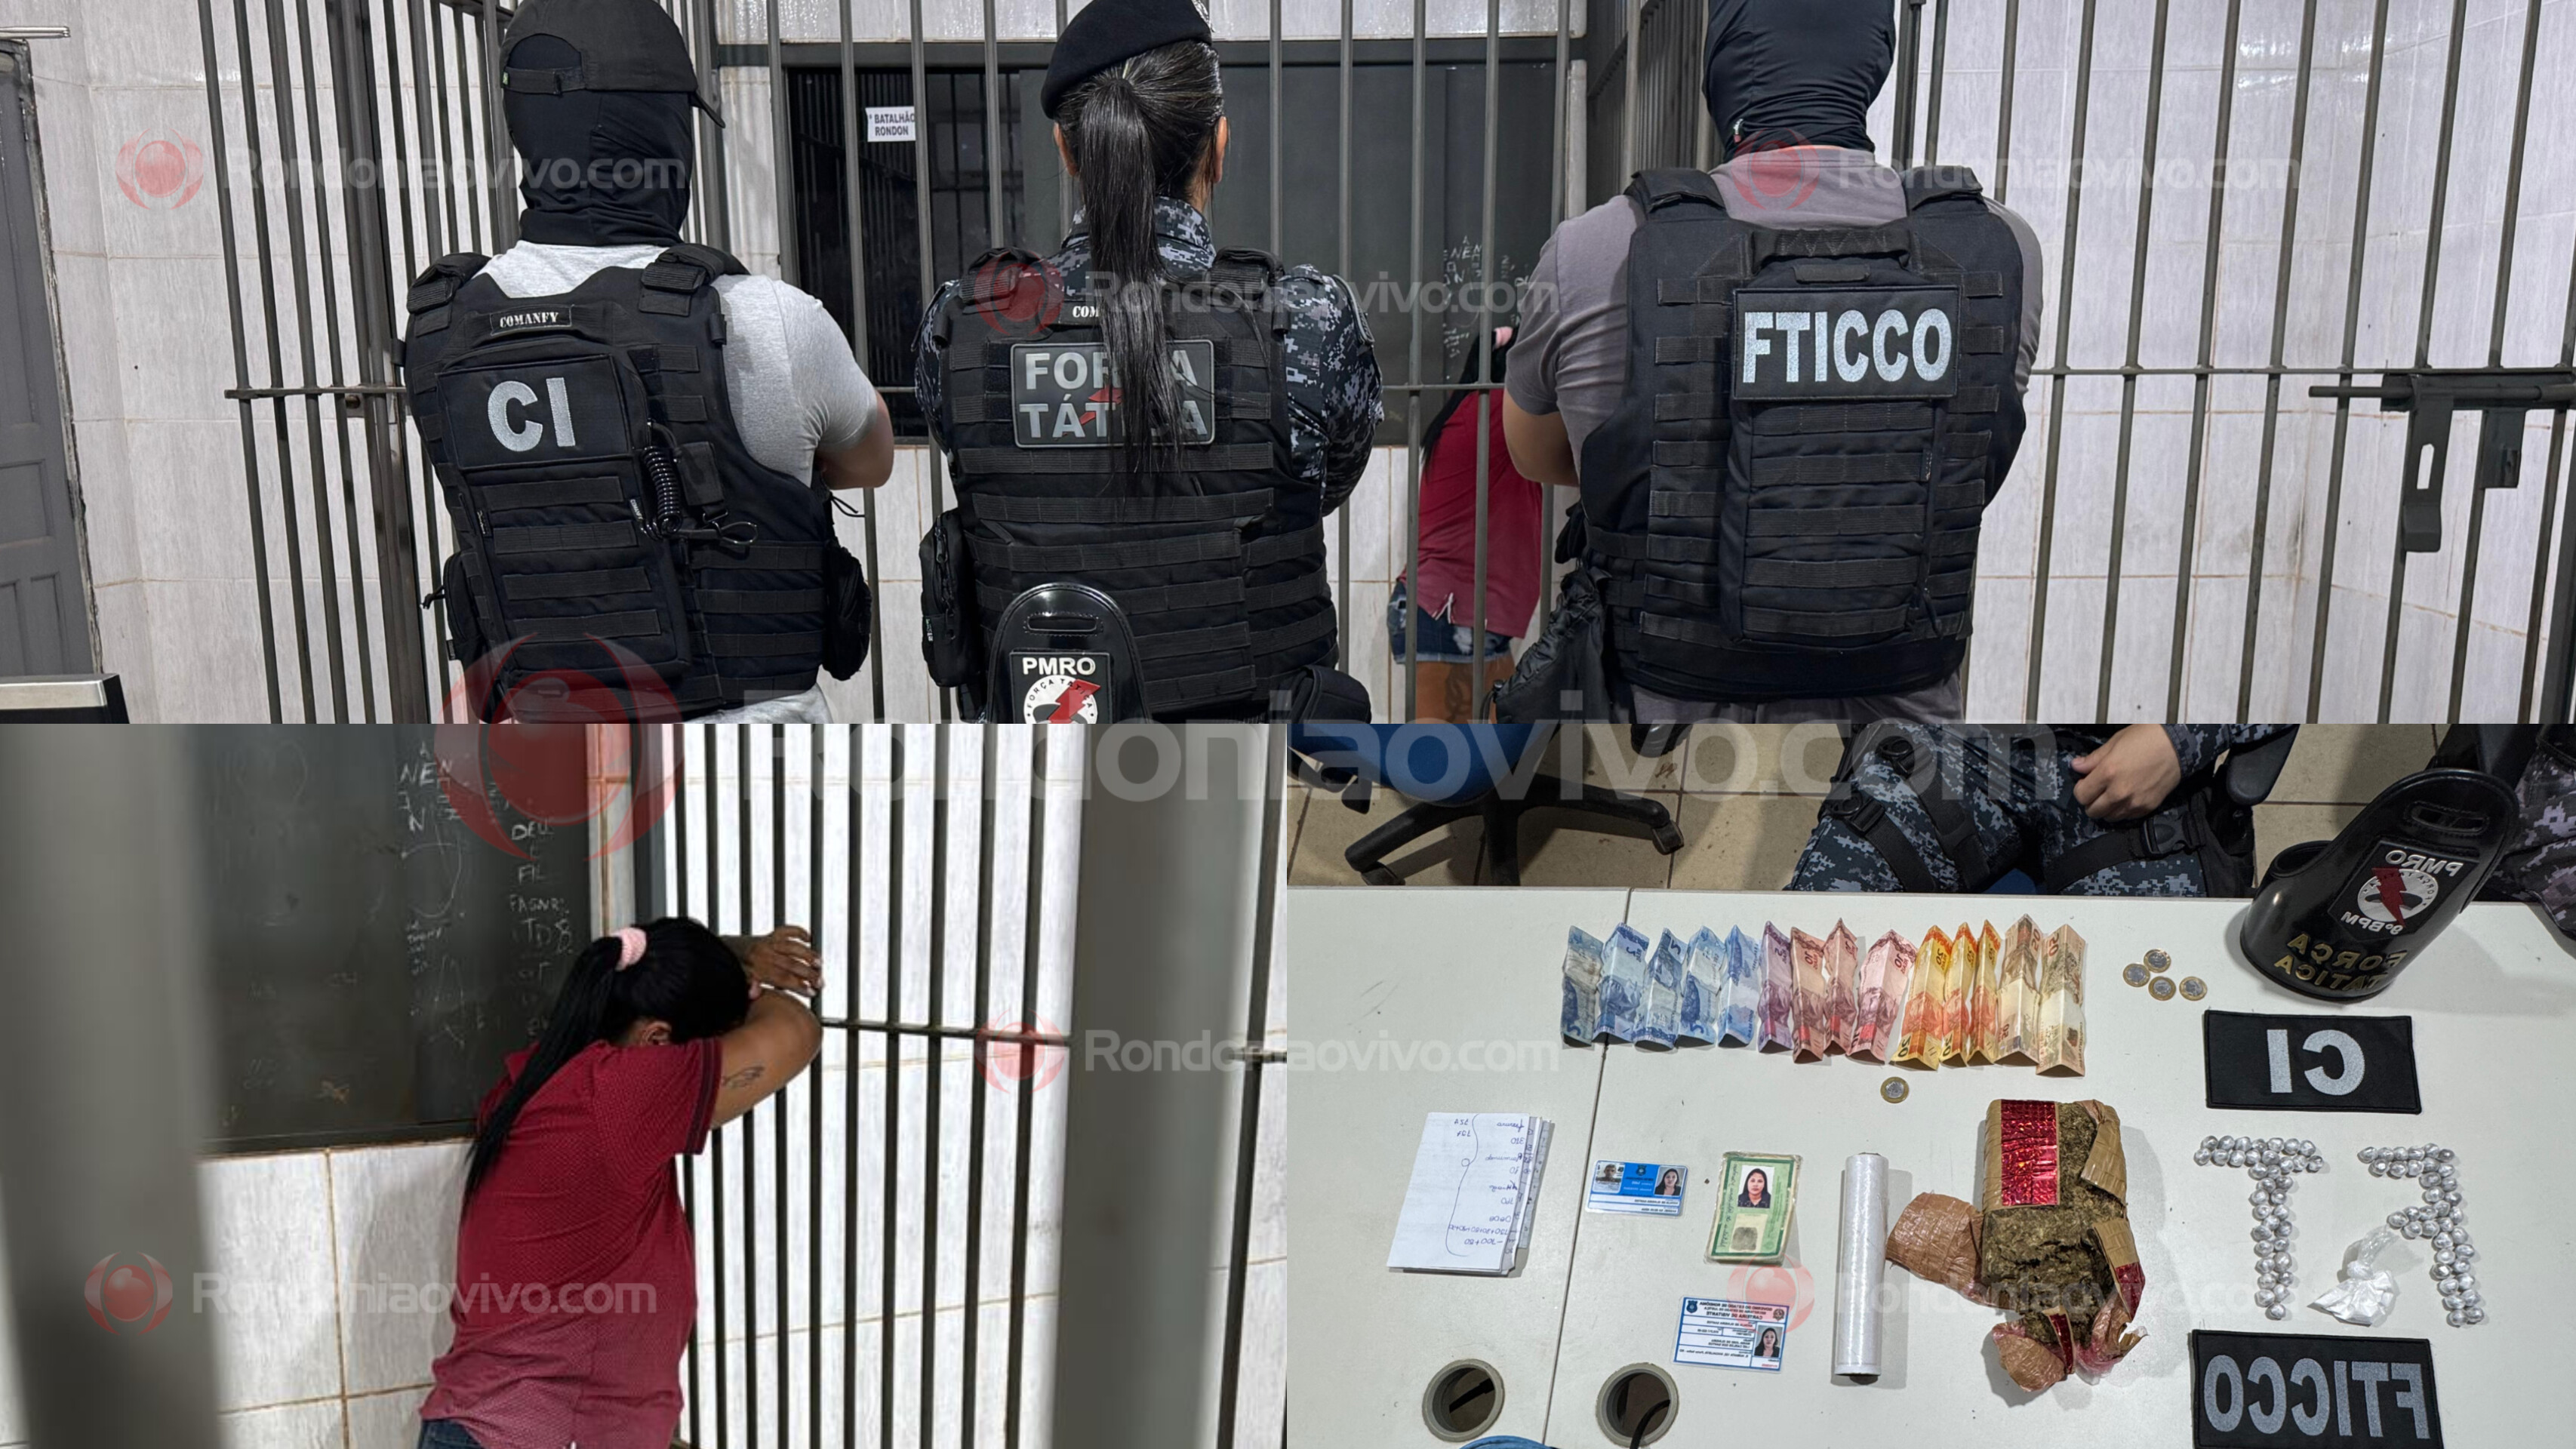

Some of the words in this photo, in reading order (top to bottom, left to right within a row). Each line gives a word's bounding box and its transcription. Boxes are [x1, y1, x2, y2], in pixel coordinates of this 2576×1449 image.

[876, 126, 909, 137] RONDON
[1073, 305, 1100, 318] COM
[1742, 307, 1953, 385] FTICCO
[1025, 349, 1198, 391] FORA
[487, 377, 577, 453] CI
[1022, 657, 1096, 675] PMRO
